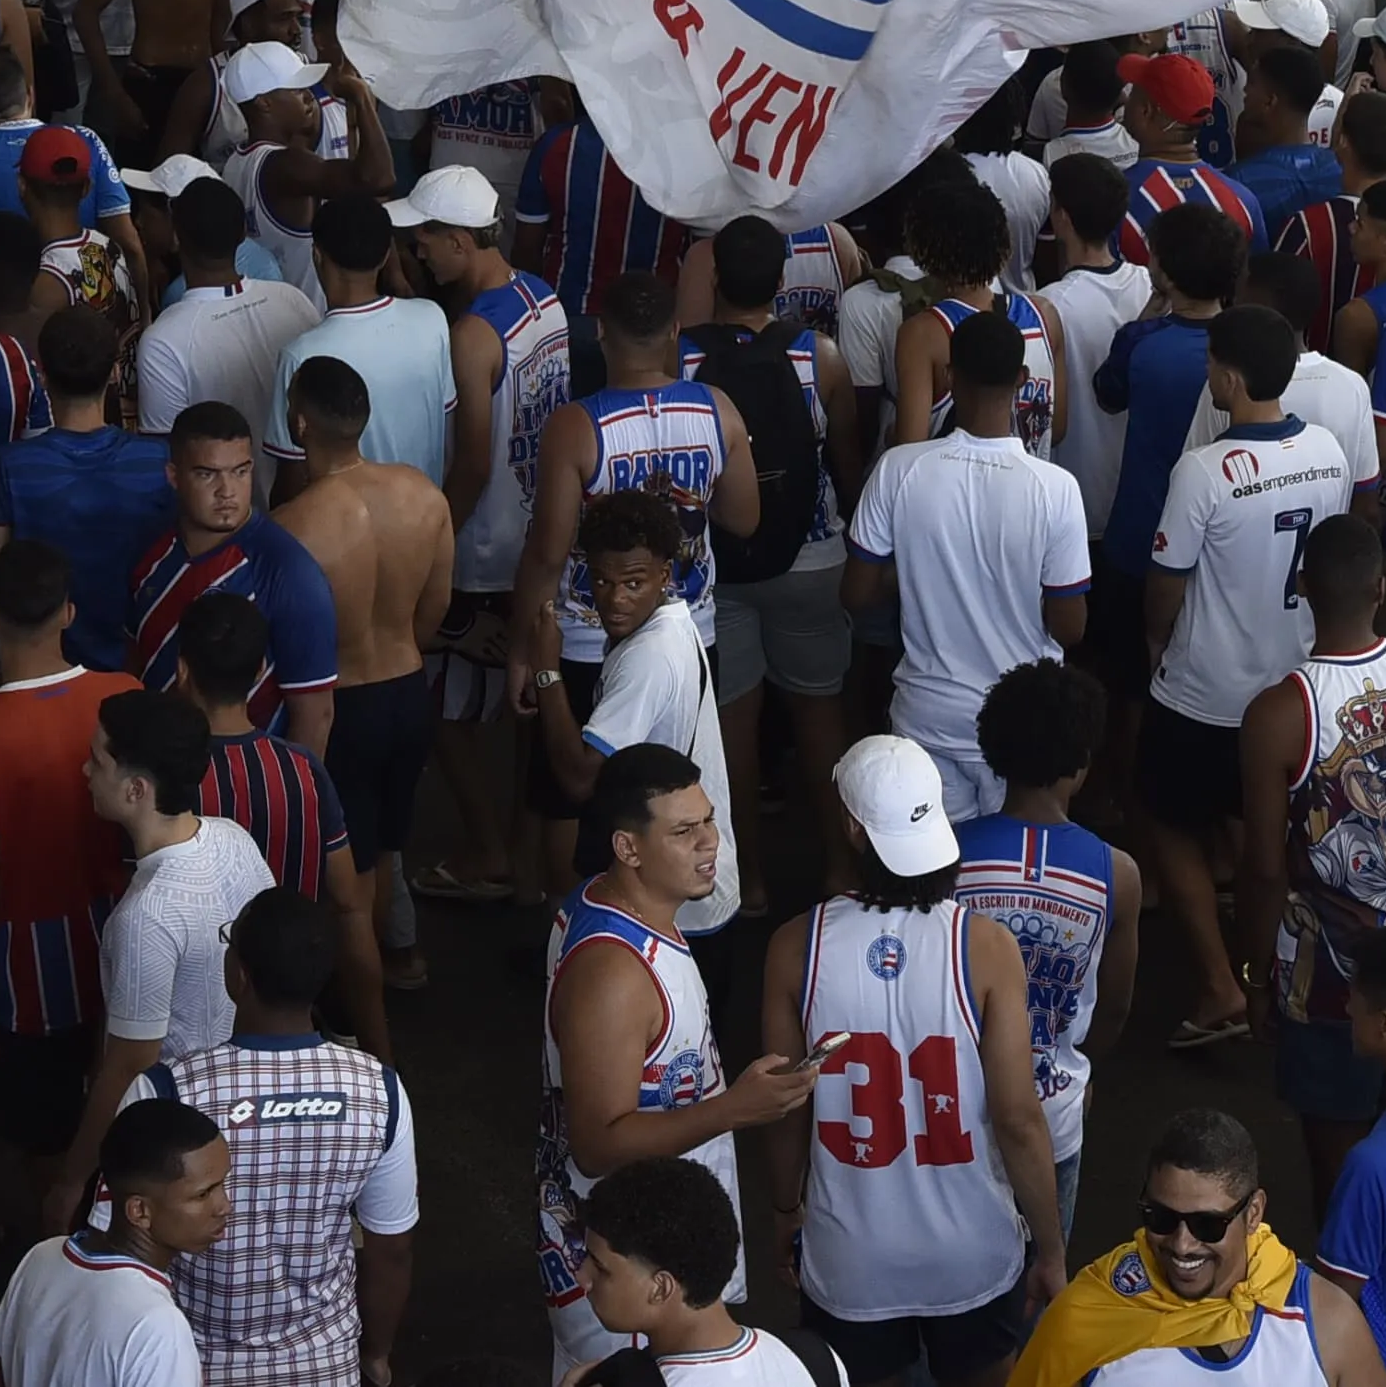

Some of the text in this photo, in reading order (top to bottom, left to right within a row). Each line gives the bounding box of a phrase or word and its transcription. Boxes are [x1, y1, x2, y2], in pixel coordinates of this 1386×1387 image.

[433, 95, 535, 135] AMOR
[709, 45, 839, 189] VEN
[611, 448, 712, 497] BAMOR
[1232, 464, 1342, 499] oas empreendimentos
[1273, 507, 1315, 611] 7
[913, 801, 930, 815] NIKE
[979, 895, 1016, 910] ESCRITO
[1018, 896, 1030, 909] NO
[1031, 898, 1091, 927] MANDAMENTO
[260, 1099, 343, 1120] lotto
[816, 1032, 975, 1169] 31
